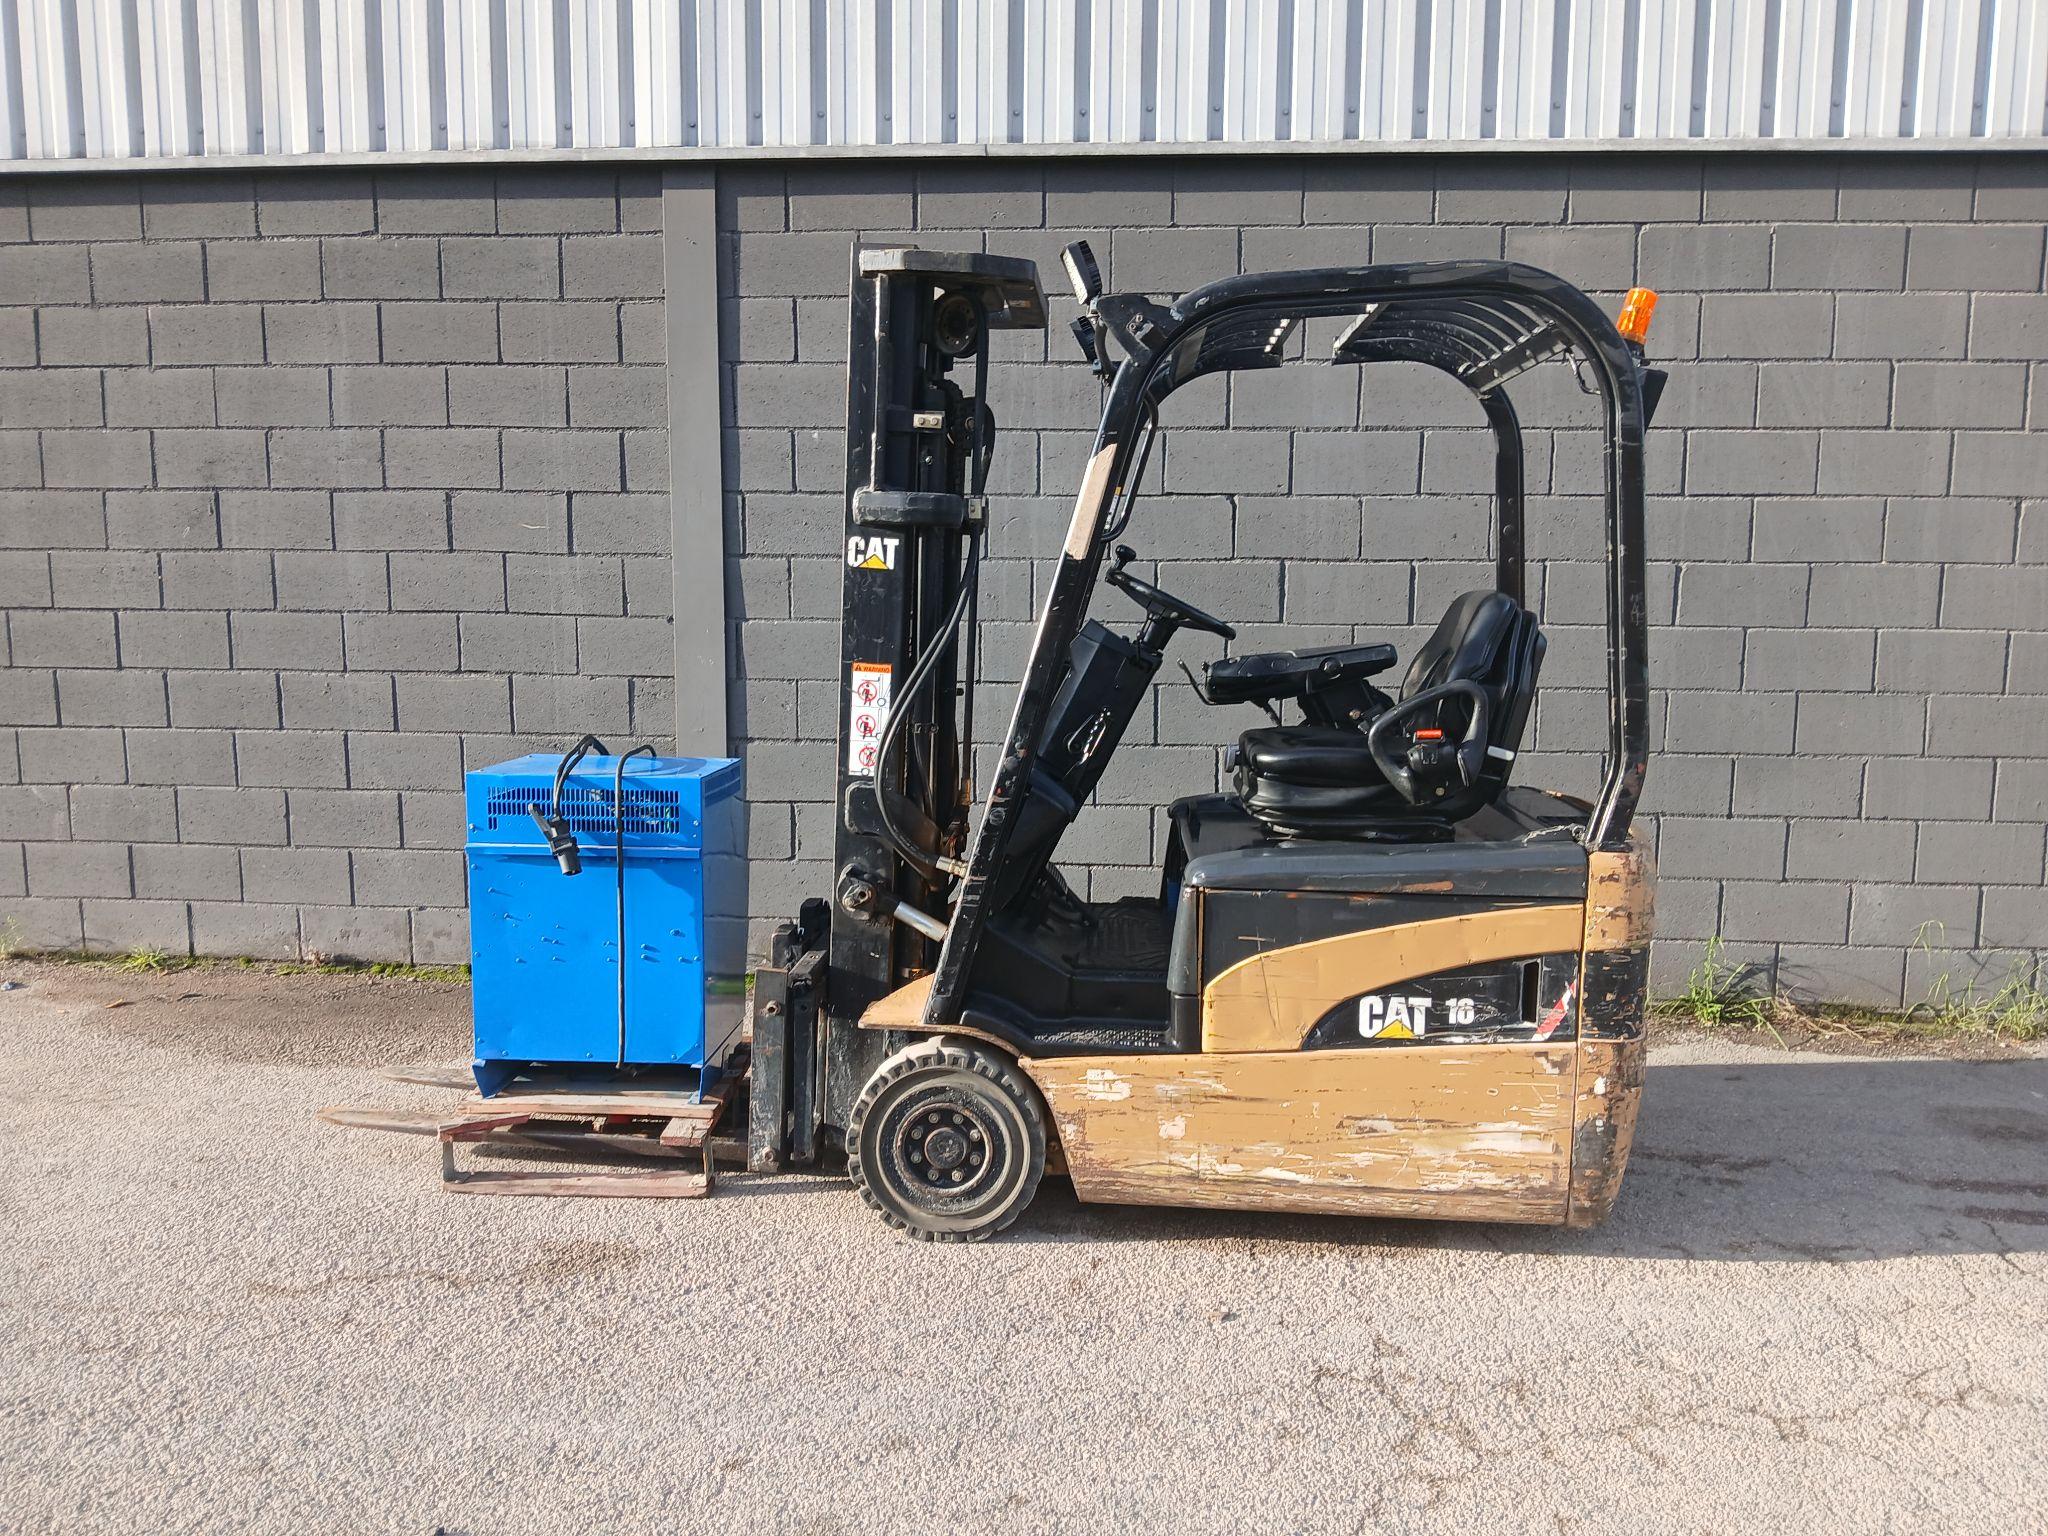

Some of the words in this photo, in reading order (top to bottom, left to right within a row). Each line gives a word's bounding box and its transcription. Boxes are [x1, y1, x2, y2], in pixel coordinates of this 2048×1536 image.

[848, 536, 899, 570] CAT
[863, 666, 890, 674] WARNING
[1359, 996, 1432, 1039] CAT
